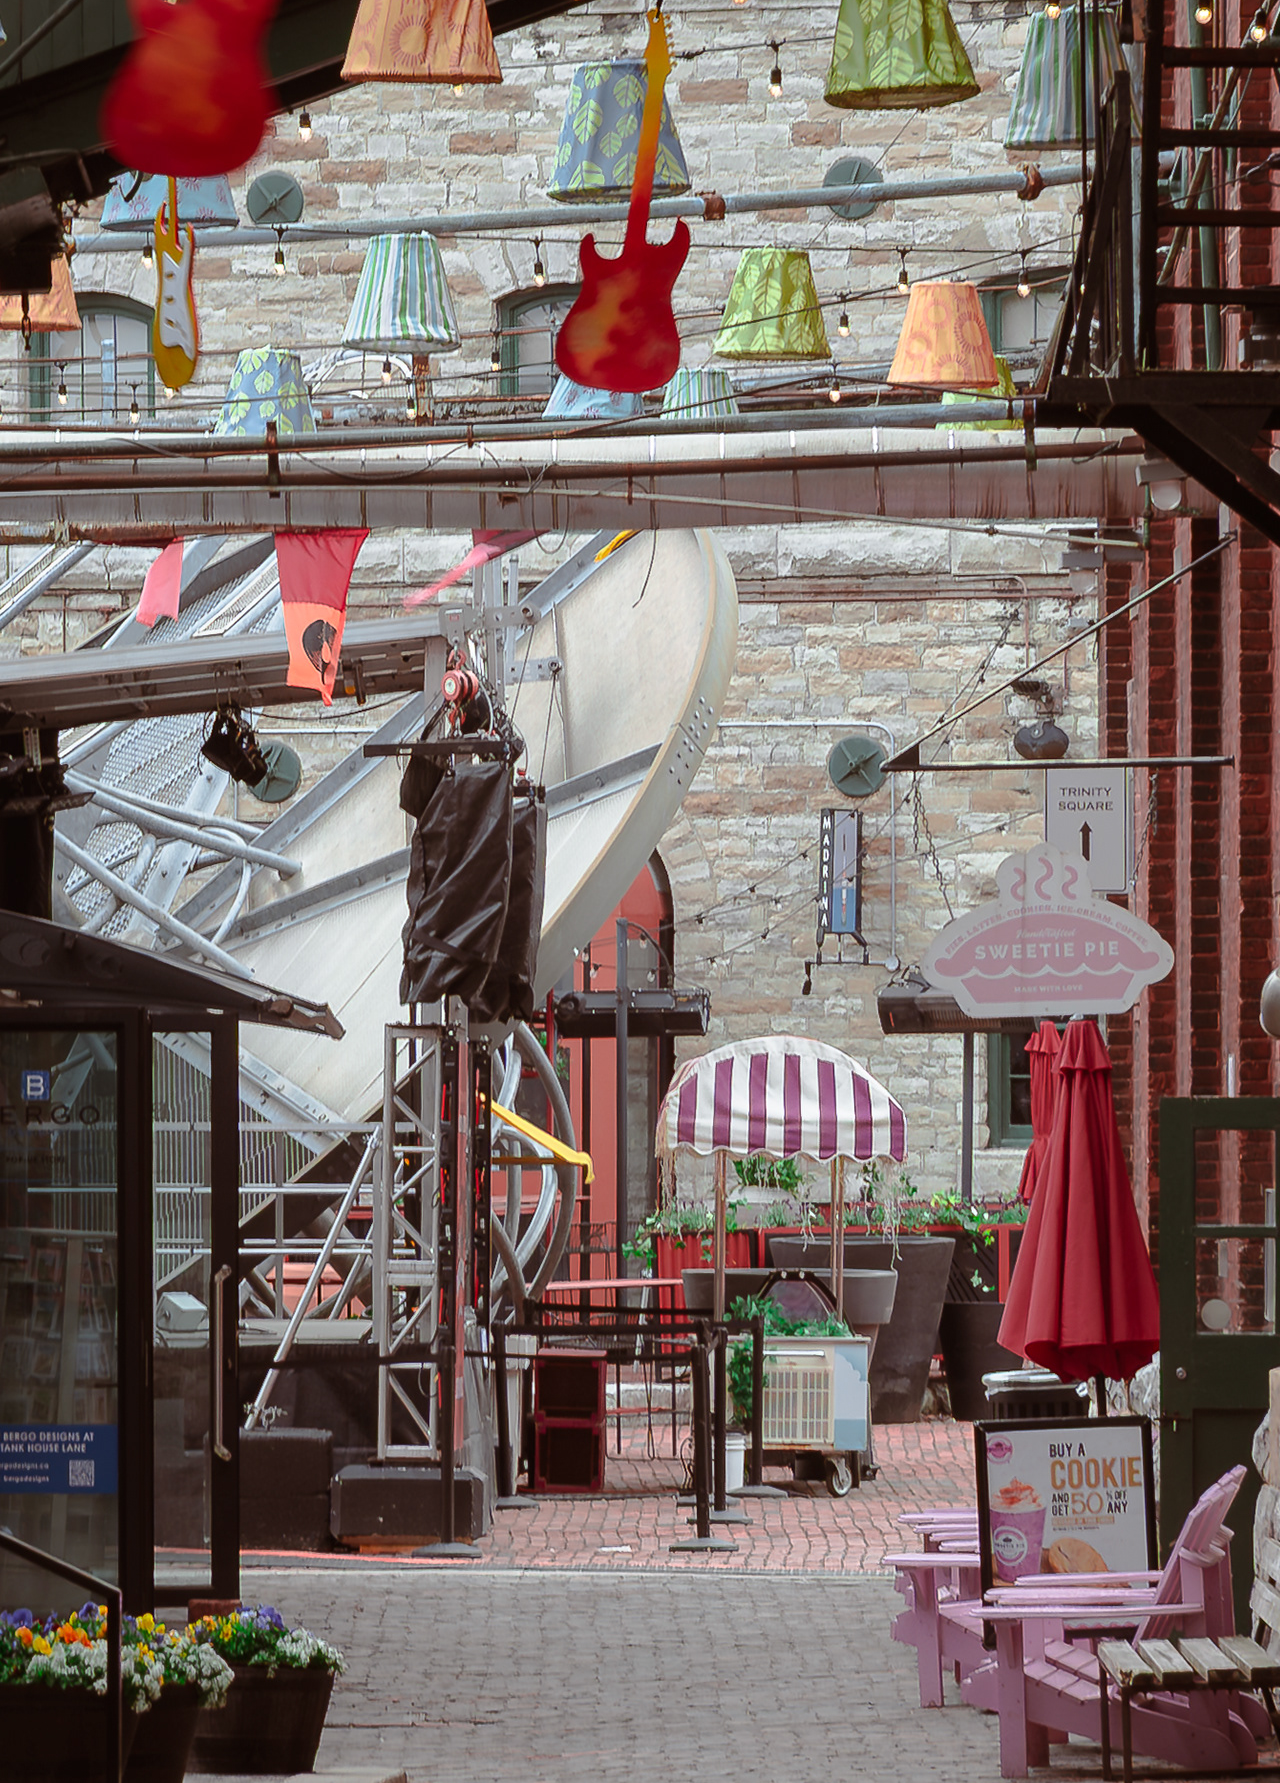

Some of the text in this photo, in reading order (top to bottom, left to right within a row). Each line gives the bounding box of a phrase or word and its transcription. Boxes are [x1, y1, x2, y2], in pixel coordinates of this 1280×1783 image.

[1059, 786, 1112, 797] TRINITY
[1058, 800, 1114, 812] SQUARE
[820, 815, 832, 928] MADRINA
[975, 940, 1120, 961] SWEETIE PIE
[1039, 984, 1061, 993] WITH
[1062, 983, 1084, 992] LOVE
[25, 1074, 45, 1096] B
[3, 1431, 37, 1442] BERGO
[39, 1431, 81, 1442] DESIGNS
[83, 1431, 95, 1442] AT
[0, 1443, 25, 1453] TANK
[27, 1443, 60, 1453] HOUSE
[62, 1443, 87, 1453] LANE
[1049, 1443, 1087, 1458] BUY A
[1050, 1456, 1143, 1490] COOKIE
[1051, 1492, 1070, 1503] AND
[1071, 1491, 1104, 1515] 50
[1051, 1501, 1128, 1516] GET ANY
